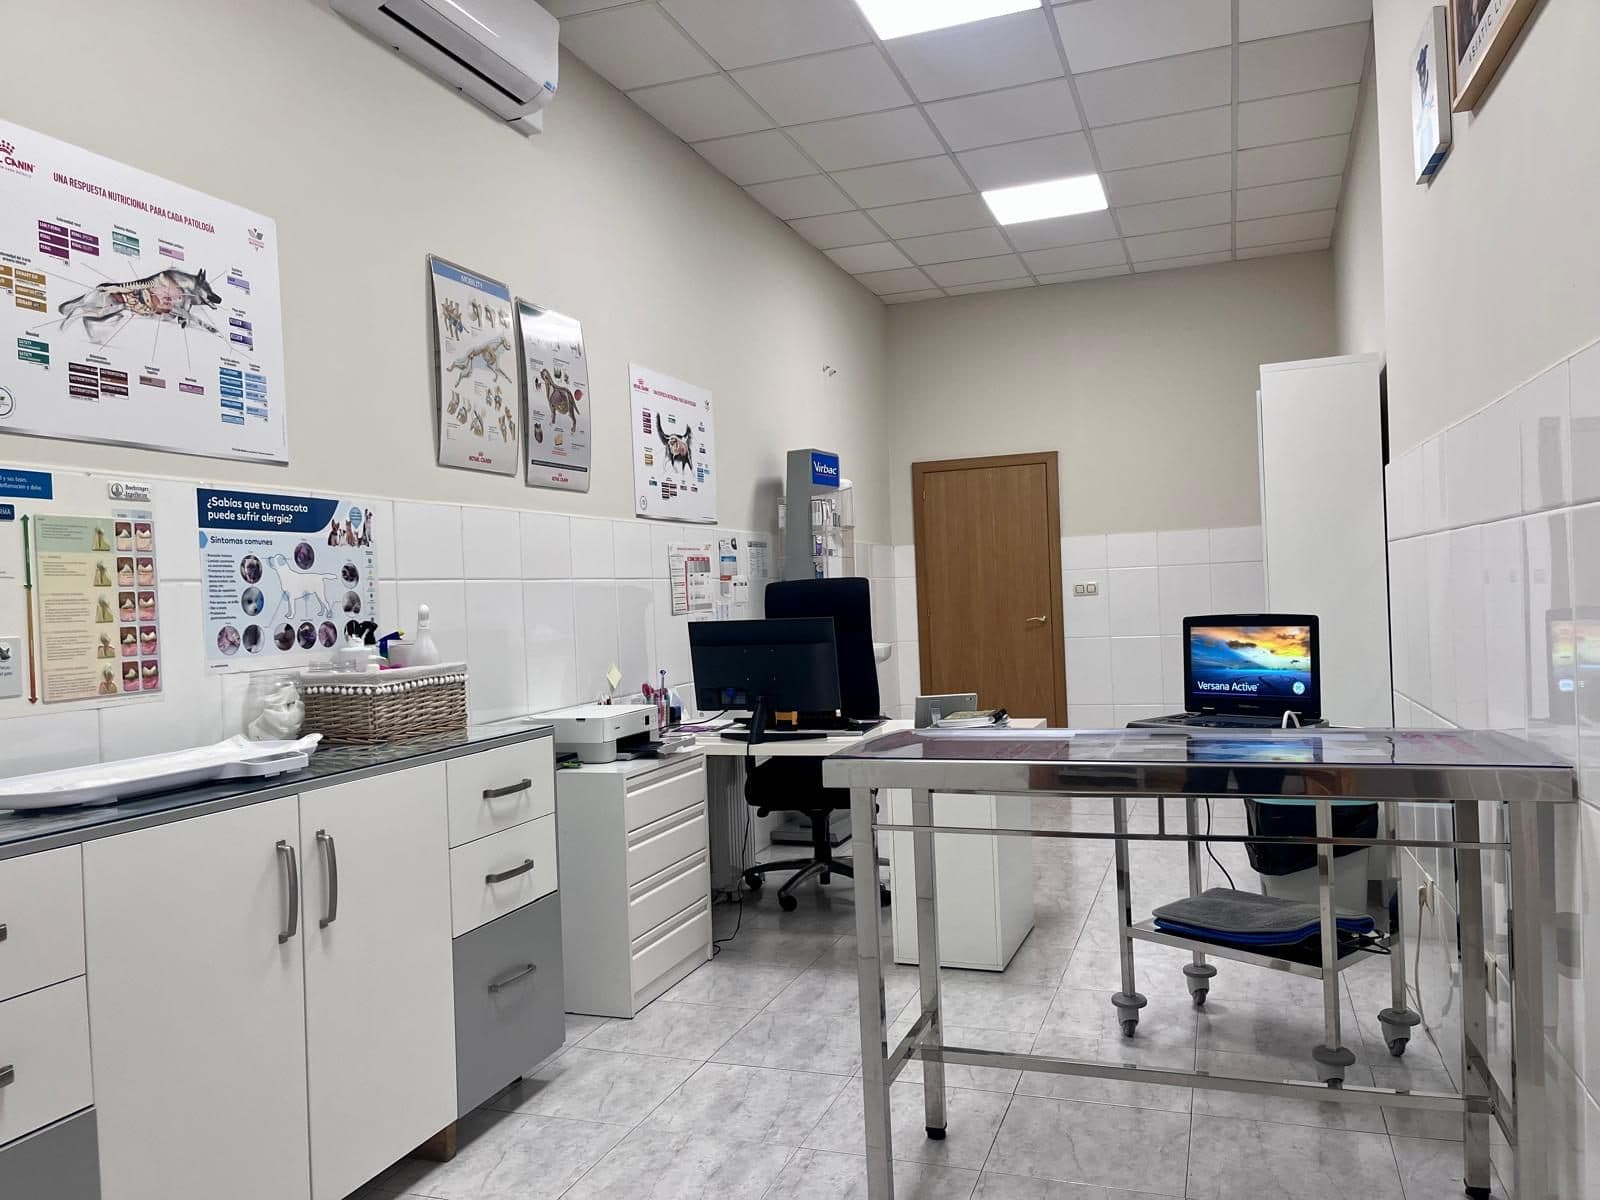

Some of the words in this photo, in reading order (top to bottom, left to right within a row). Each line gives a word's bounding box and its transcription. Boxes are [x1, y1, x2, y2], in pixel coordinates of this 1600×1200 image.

[4, 156, 34, 174] CANIN
[53, 172, 68, 187] UNA
[69, 176, 107, 199] RESPUESTA
[107, 189, 148, 213] NUTRICIONAL
[149, 201, 166, 217] PARA
[167, 206, 183, 222] CADA
[183, 210, 215, 235] PATOLOGÍA
[813, 460, 838, 475] Virbac
[207, 496, 242, 509] ¿Sabías
[244, 501, 260, 512] que
[261, 502, 271, 511] tu
[272, 503, 308, 513] mascota
[207, 511, 235, 522] puede
[237, 512, 260, 523] sufrir
[261, 513, 293, 525] alergia?
[210, 536, 242, 546] Síntomas
[244, 538, 273, 546] comunes
[1197, 681, 1230, 692] Versana
